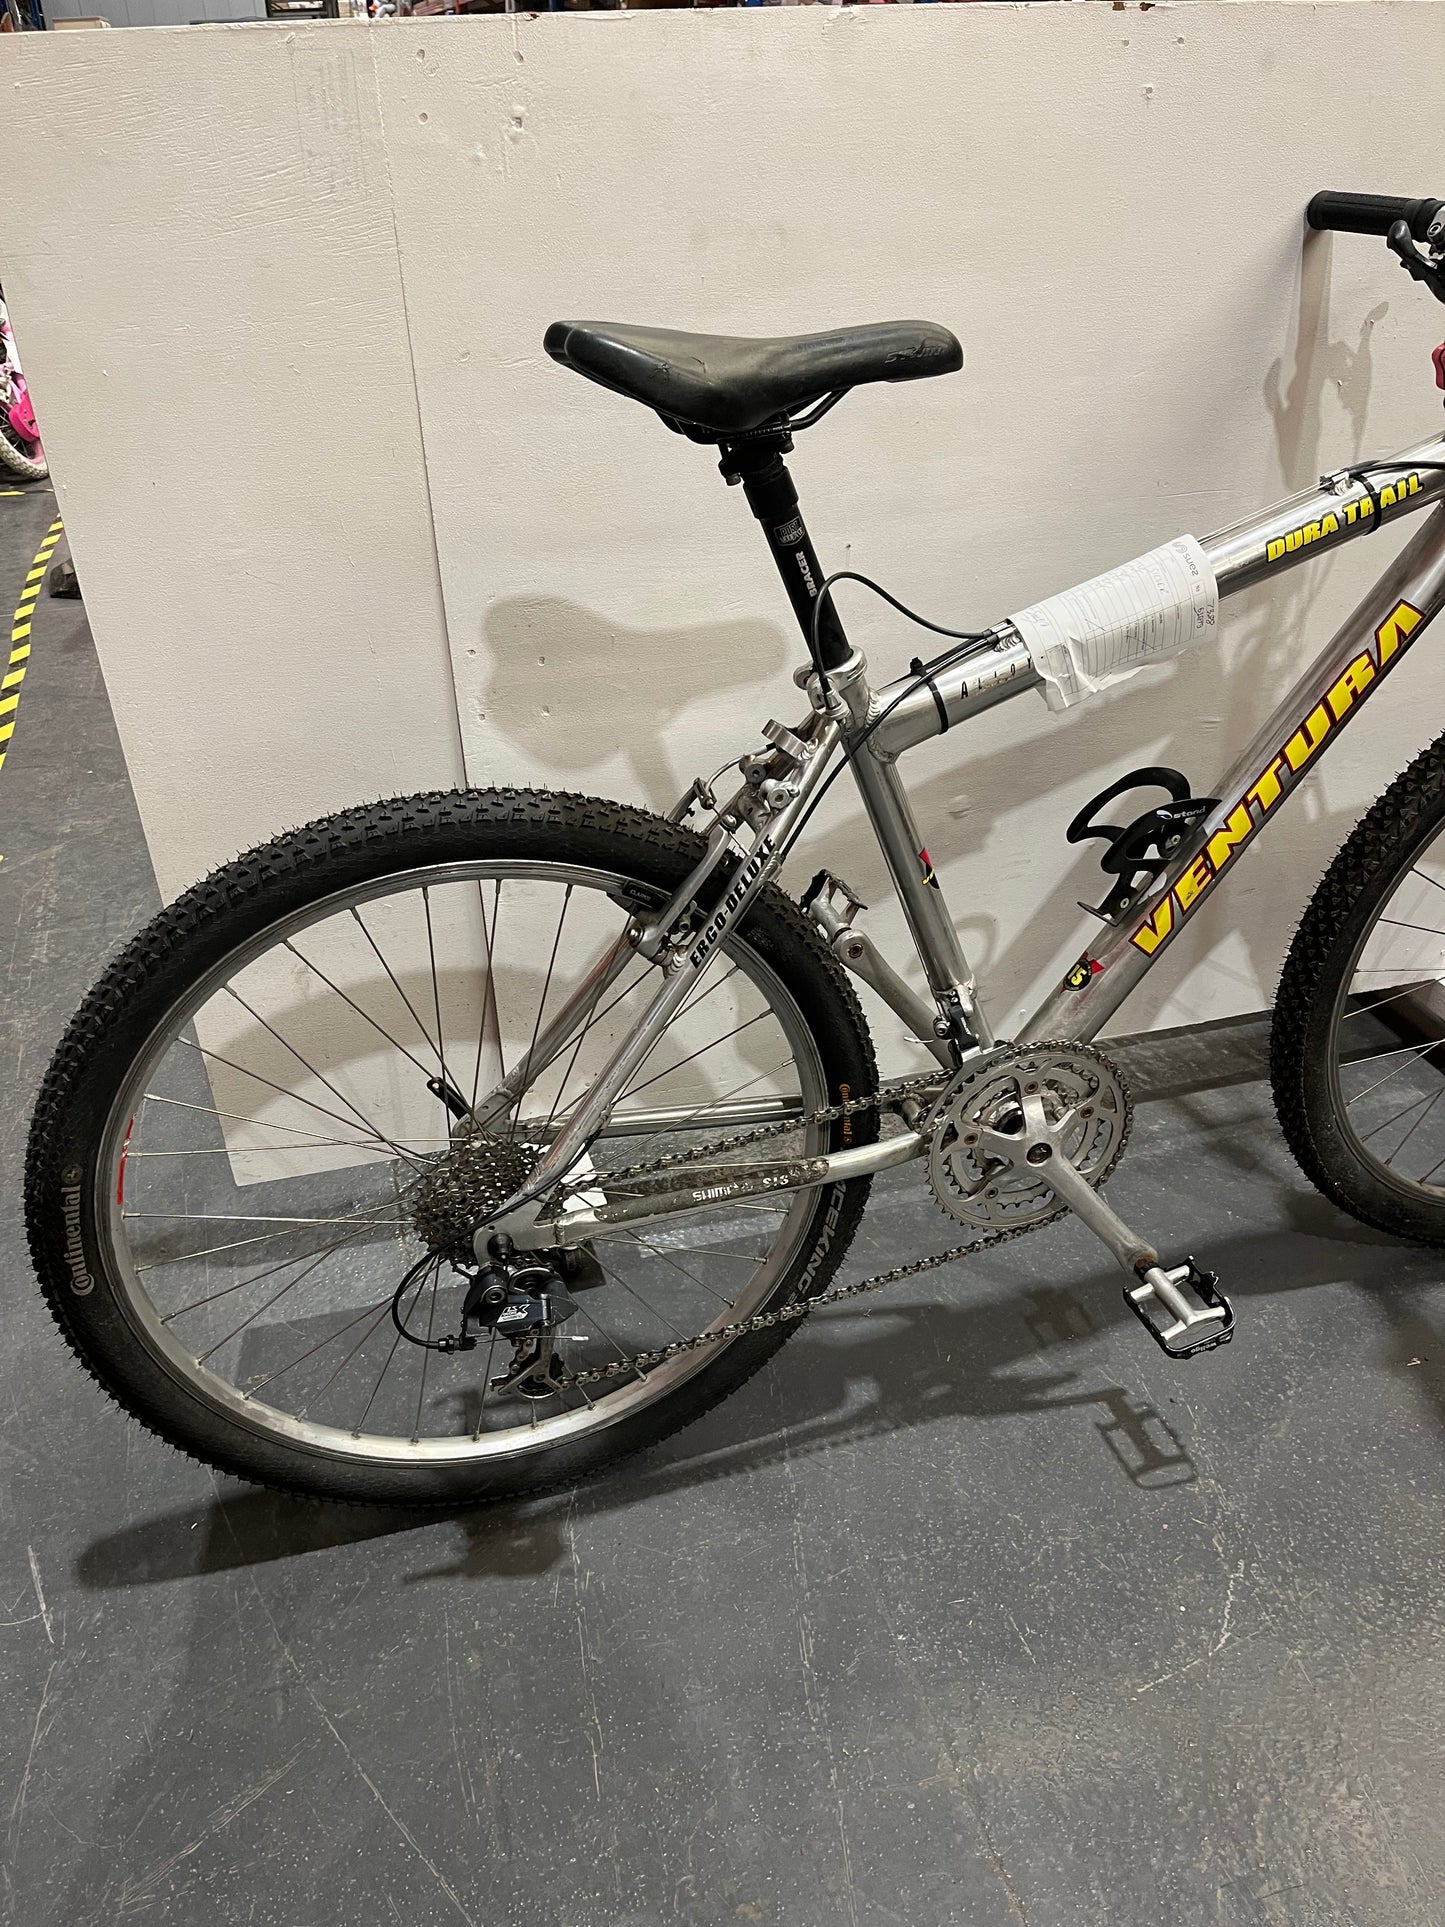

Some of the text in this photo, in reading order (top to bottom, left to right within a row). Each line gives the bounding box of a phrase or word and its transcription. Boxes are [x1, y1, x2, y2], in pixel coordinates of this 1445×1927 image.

[1183, 552, 1199, 577] suez
[1265, 471, 1425, 564] DURA TRAIL
[795, 551, 818, 598] BRACER
[1128, 598, 1425, 958] VENTURA
[689, 834, 776, 969] ERGO-DELUXE
[61, 1184, 95, 1296] Continental
